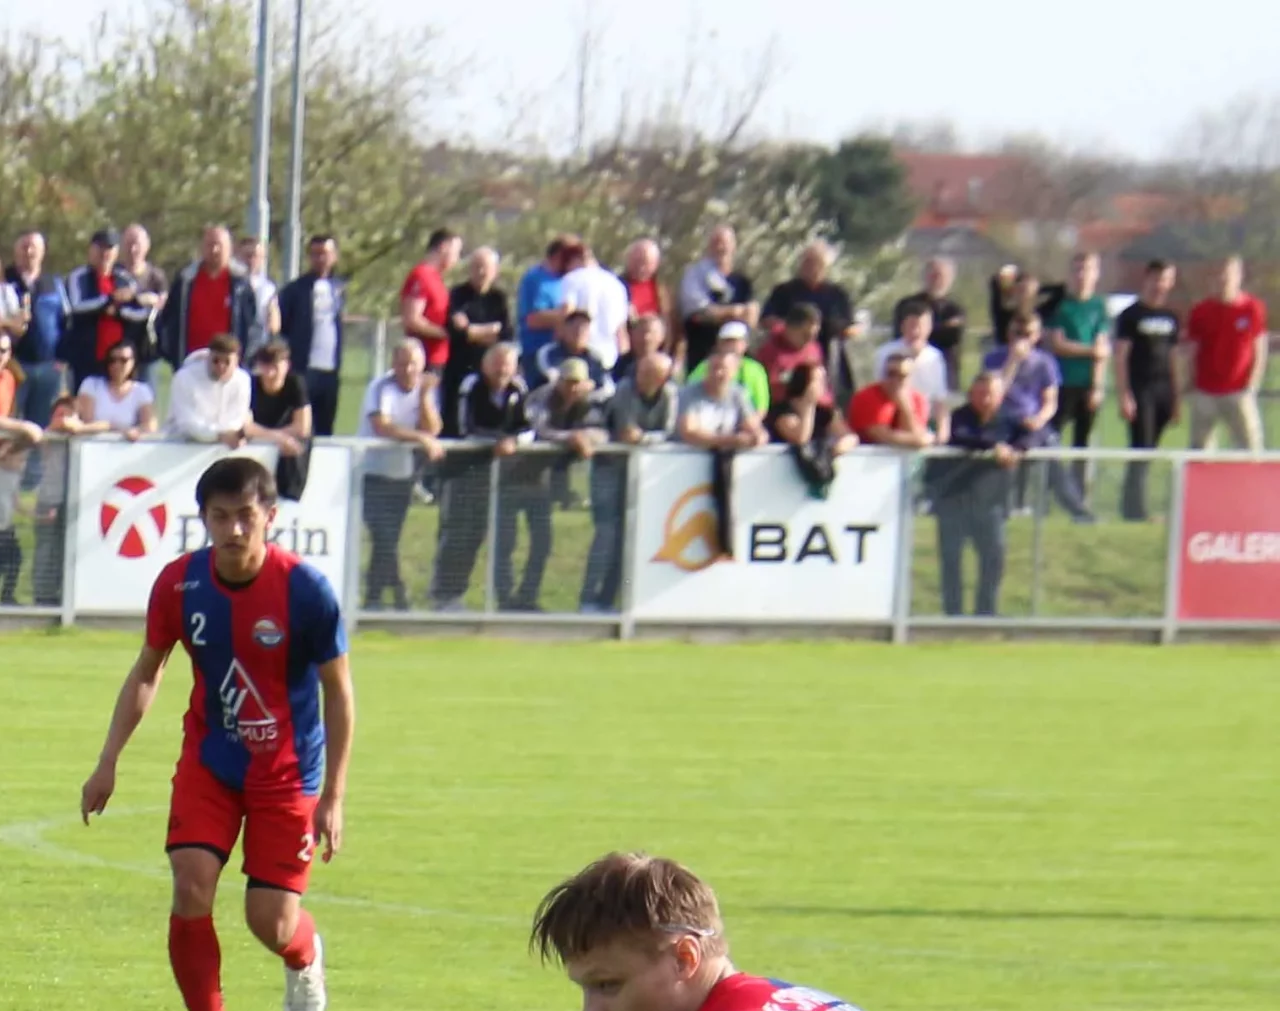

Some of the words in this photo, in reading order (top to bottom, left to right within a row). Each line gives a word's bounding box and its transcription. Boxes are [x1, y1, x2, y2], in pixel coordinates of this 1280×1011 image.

[750, 523, 880, 564] BAT
[191, 612, 207, 646] 2
[296, 833, 313, 862] 2
